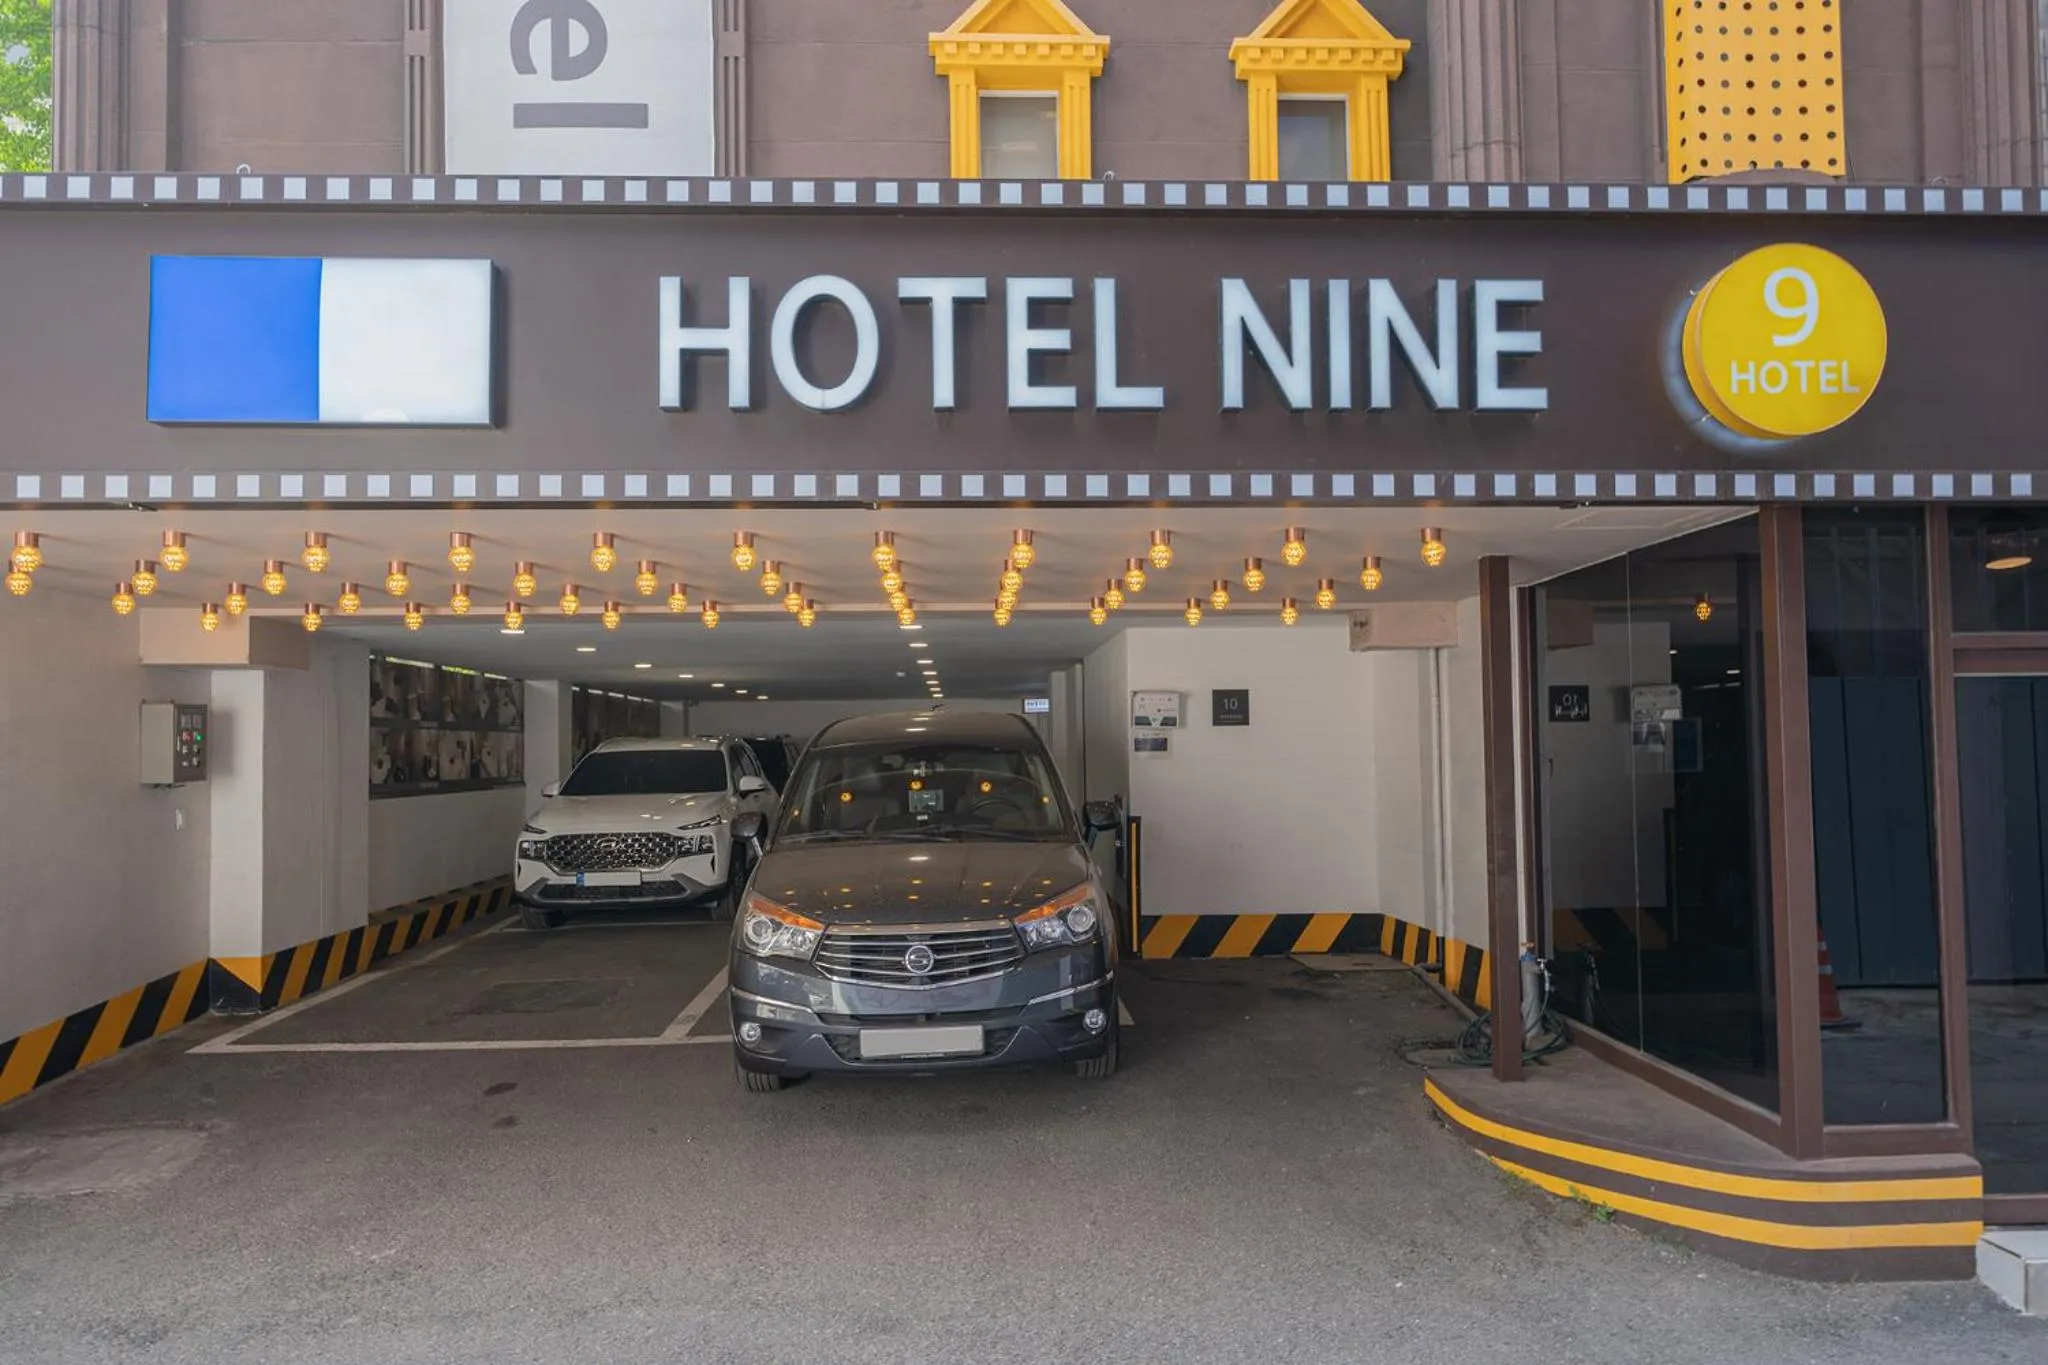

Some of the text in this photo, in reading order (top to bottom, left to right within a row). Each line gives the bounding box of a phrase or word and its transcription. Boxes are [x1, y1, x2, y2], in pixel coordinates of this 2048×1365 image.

[1763, 266, 1819, 347] 9
[658, 274, 1548, 412] HOTEL NINE
[1730, 359, 1861, 395] HOTEL
[1222, 698, 1239, 710] 10
